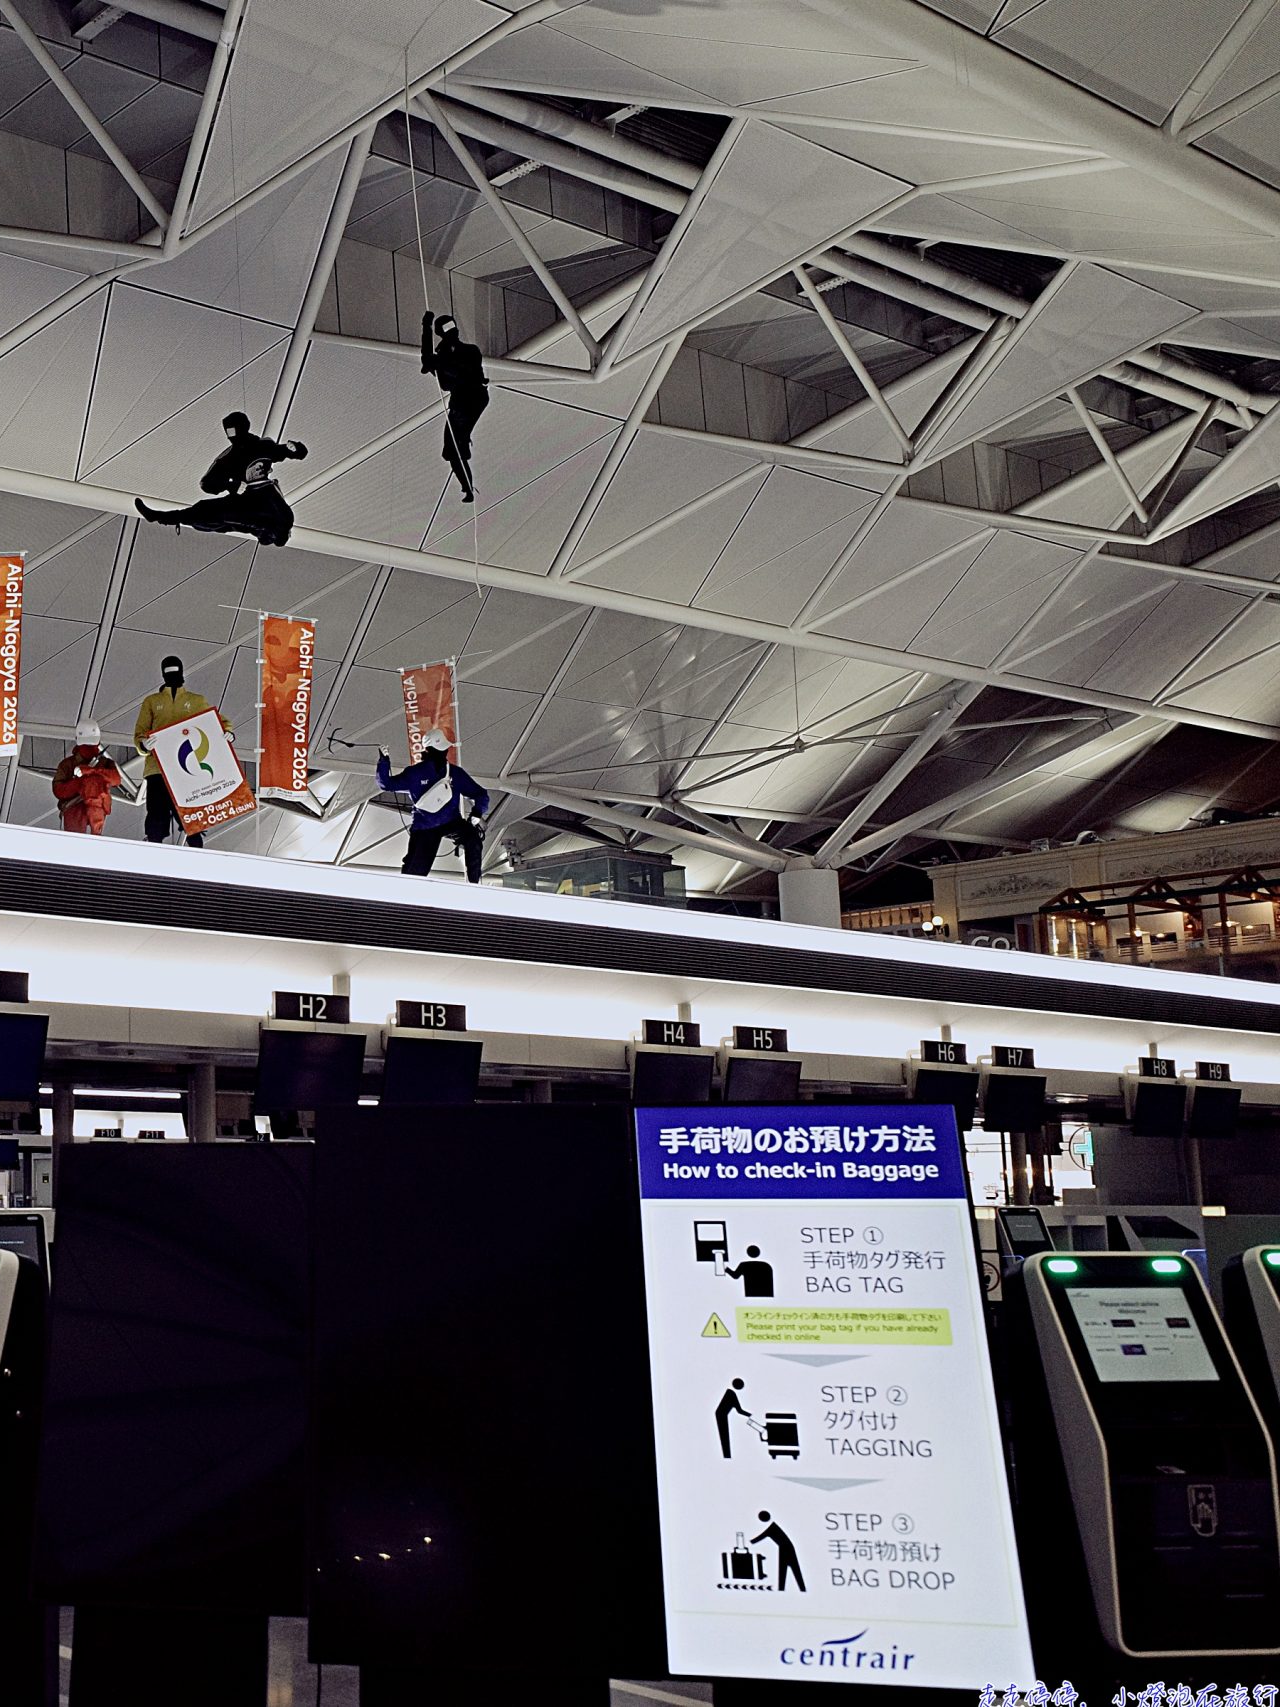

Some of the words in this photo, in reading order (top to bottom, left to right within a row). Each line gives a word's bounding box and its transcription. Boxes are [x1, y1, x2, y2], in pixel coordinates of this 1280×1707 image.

[0, 563, 23, 692] Aichi-Nagoya
[291, 628, 314, 743] Aichi-Nagoya
[2, 697, 18, 744] 2026
[292, 748, 307, 790] 2026
[185, 784, 223, 803] Aichi-Nagoya
[223, 780, 237, 789] 2026
[183, 811, 204, 824] Sep
[299, 997, 327, 1019] H2
[421, 1005, 447, 1027] H3
[663, 1025, 685, 1044] H4
[753, 1030, 773, 1050] H5
[938, 1042, 955, 1062] H6
[1008, 1049, 1023, 1066] H7
[1153, 1059, 1167, 1076] H8
[1209, 1064, 1222, 1080] H9
[101, 1130, 116, 1138] F10
[146, 1131, 159, 1139] F11
[659, 1125, 937, 1154] 手荷物のお預け方法
[663, 1163, 710, 1179] How
[716, 1163, 738, 1179] to
[744, 1162, 836, 1179] check-in
[843, 1162, 939, 1182] Baggage
[800, 1227, 854, 1243] STEP
[803, 1250, 946, 1270] 手荷物タグ発行
[806, 1276, 851, 1293] BAG
[858, 1277, 904, 1293] TAG
[746, 1323, 773, 1331] Please
[776, 1323, 796, 1333] print
[799, 1325, 818, 1334] your
[821, 1323, 837, 1333] bag
[838, 1324, 853, 1334] tag
[864, 1325, 880, 1334] you
[882, 1324, 903, 1332] have
[906, 1324, 939, 1334] already
[747, 1333, 782, 1341] checked
[784, 1333, 792, 1341] in
[794, 1333, 820, 1341] online
[821, 1385, 877, 1403] STEP
[824, 1410, 898, 1431] タグ付け
[825, 1438, 933, 1458] TAGGING
[825, 1512, 882, 1532] STEP
[828, 1539, 942, 1563] 手荷物預け
[831, 1568, 880, 1588] BAG
[889, 1570, 956, 1591] DROP
[780, 1645, 915, 1670] centrair
